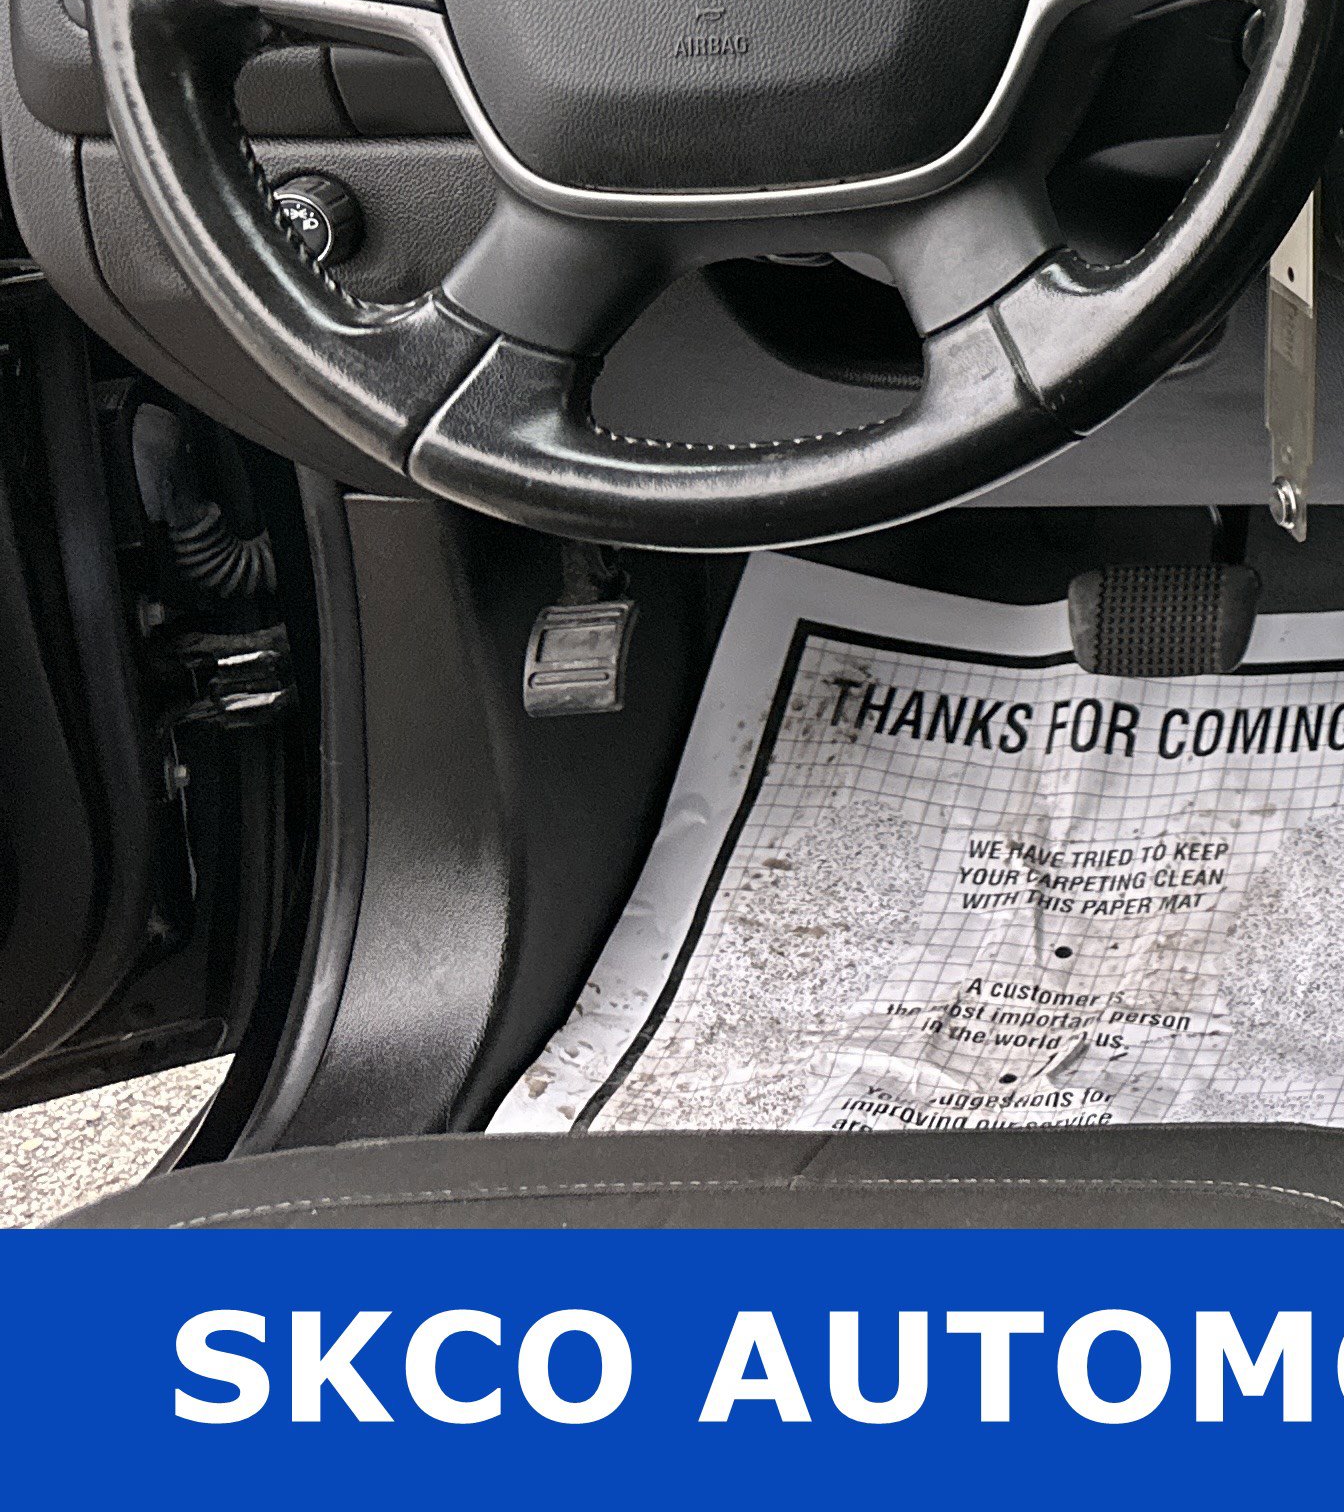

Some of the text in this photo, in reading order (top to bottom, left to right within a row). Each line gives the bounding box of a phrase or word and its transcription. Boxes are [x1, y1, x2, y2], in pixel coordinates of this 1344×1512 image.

[675, 36, 749, 58] AIRBAG
[826, 682, 1034, 755] THANKS
[1044, 696, 1141, 757] FOR
[968, 839, 1230, 870] WE HAVE TRIED TO KEEP
[957, 867, 1020, 888] YOUR
[1153, 868, 1226, 888] CLEAN
[961, 890, 1207, 916] WITH THIS PAPER MAT
[965, 978, 1127, 1008] A customer is
[921, 1017, 943, 1036] in
[947, 1025, 985, 1045] the
[994, 1028, 1062, 1051] world
[1094, 1033, 1130, 1052] us.
[1108, 1009, 1193, 1032] person
[842, 1097, 969, 1130] improving
